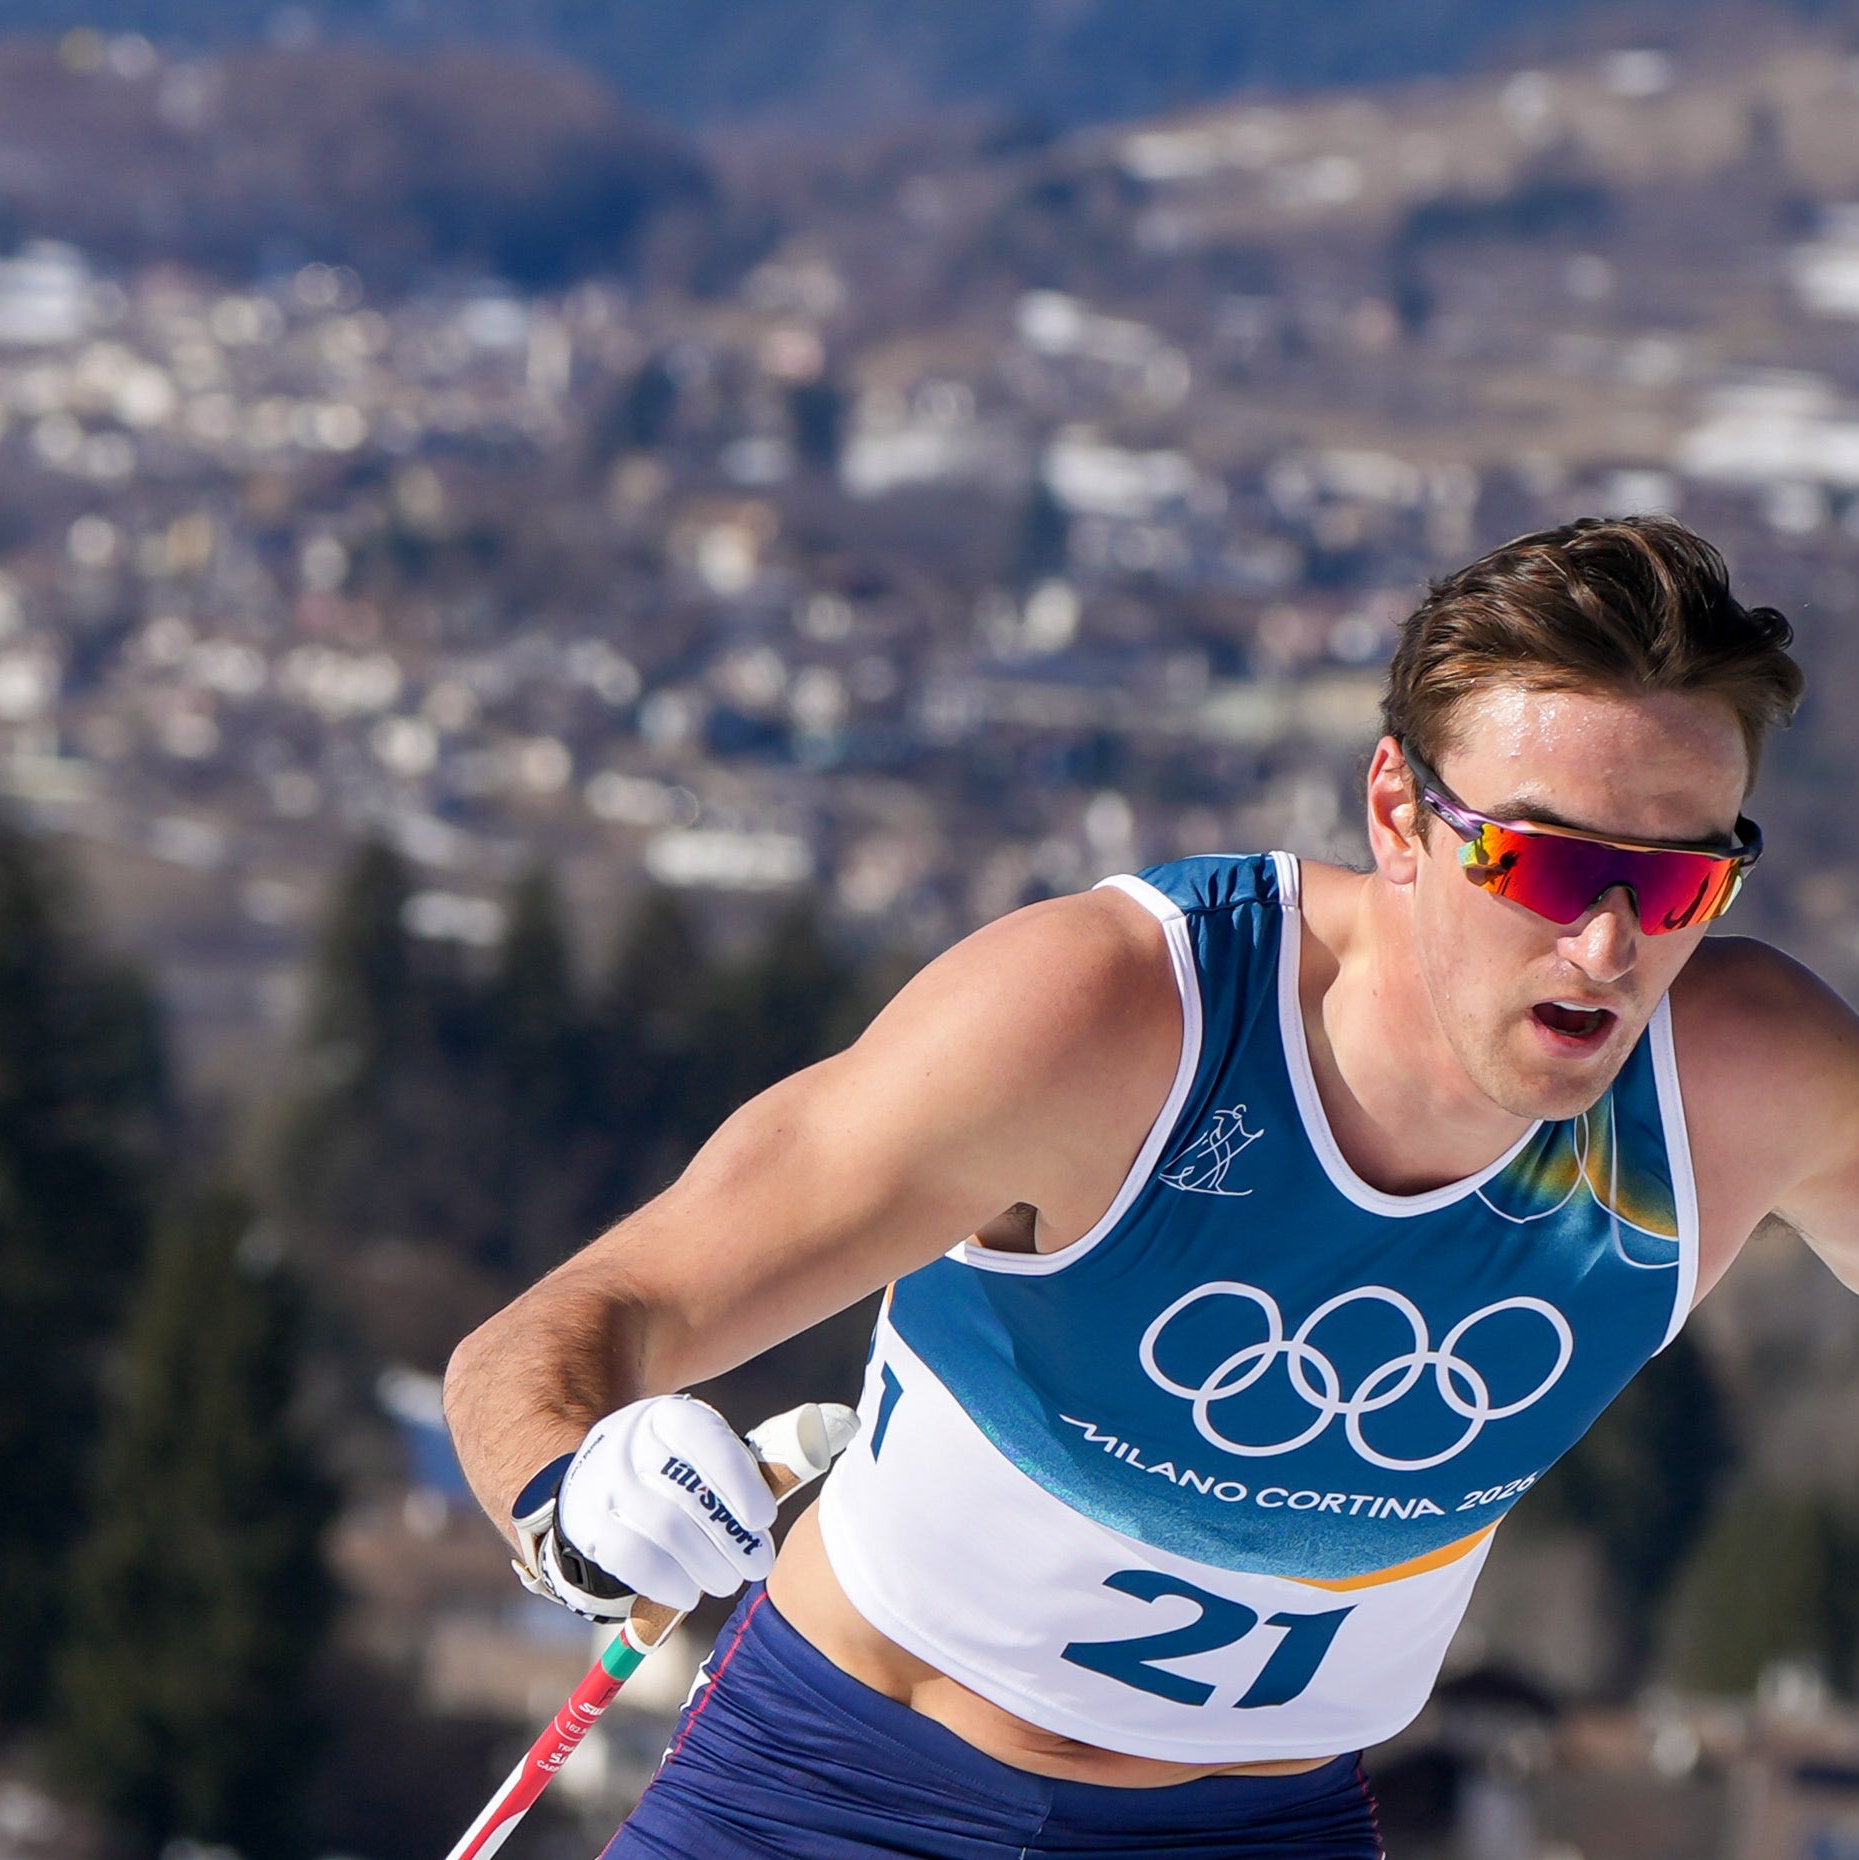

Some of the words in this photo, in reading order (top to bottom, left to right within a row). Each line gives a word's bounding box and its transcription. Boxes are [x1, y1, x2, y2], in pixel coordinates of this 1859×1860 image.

[1059, 1413, 1248, 1503] MILANO
[1255, 1486, 1447, 1520] CORTINA
[1455, 1469, 1538, 1512] 2026
[1060, 1569, 1357, 1709] 21
